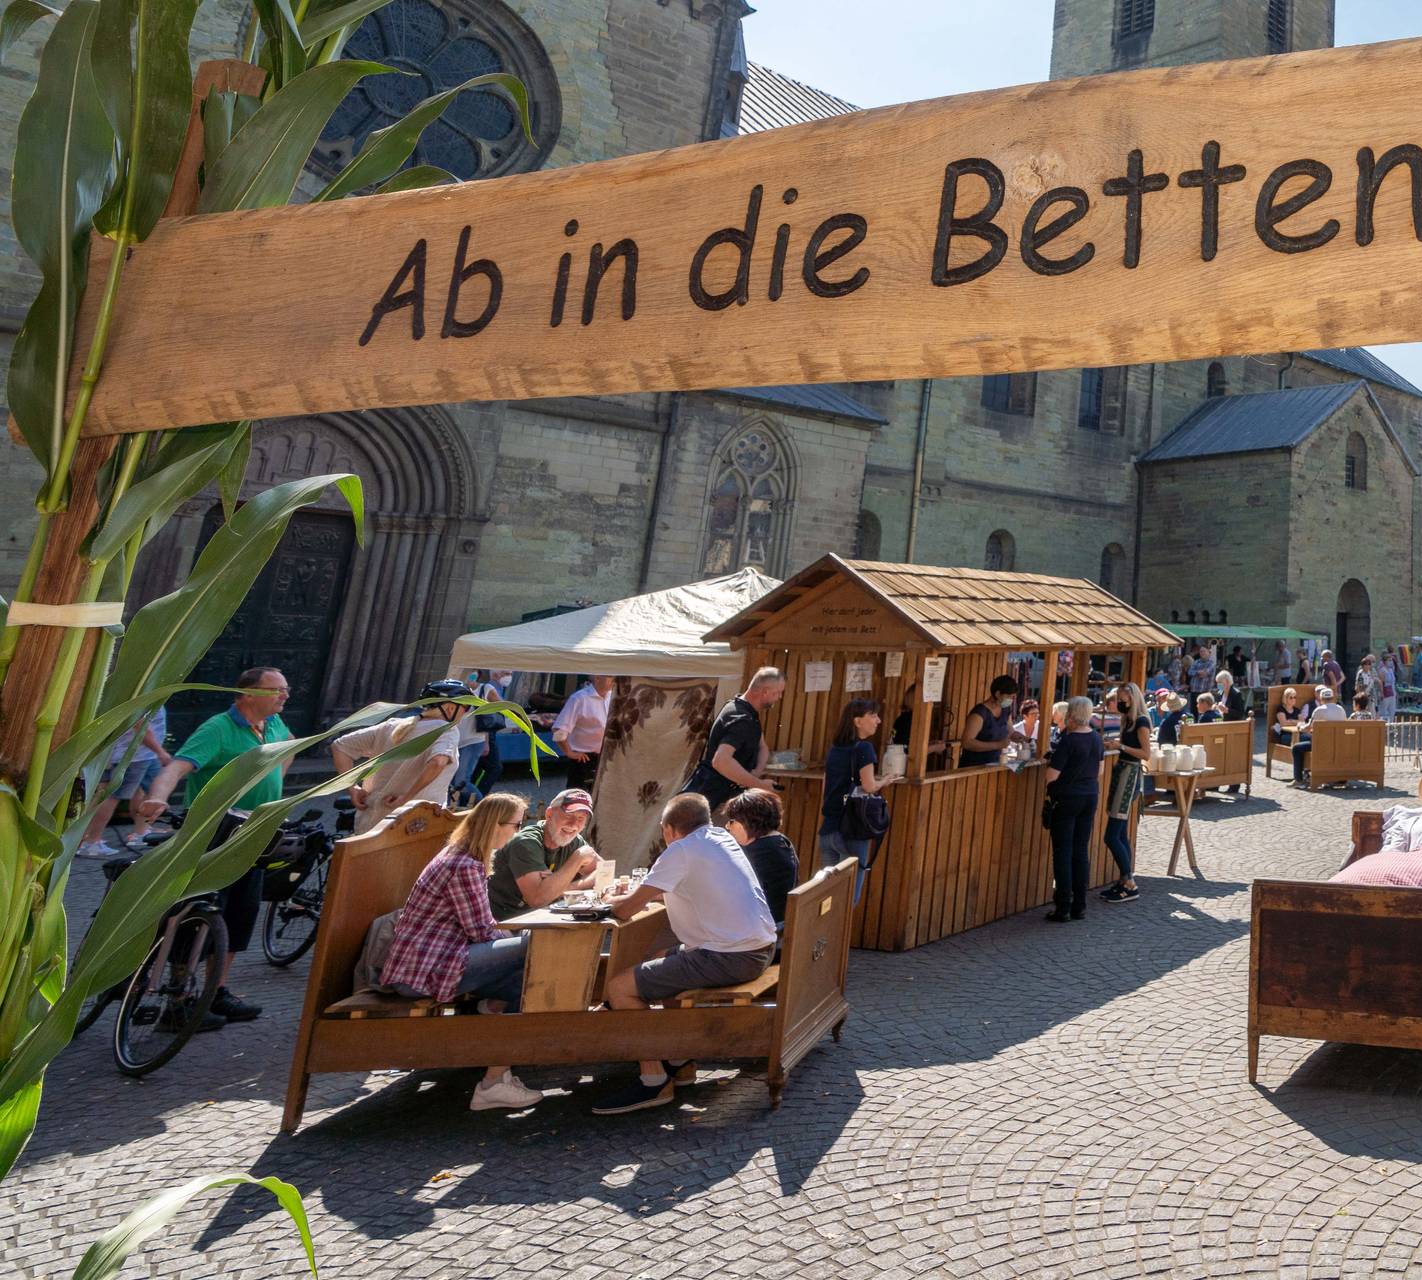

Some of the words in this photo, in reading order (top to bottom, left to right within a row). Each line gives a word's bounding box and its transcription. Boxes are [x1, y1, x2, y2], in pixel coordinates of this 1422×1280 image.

[357, 224, 505, 348] Ab
[548, 217, 641, 329] in
[687, 182, 872, 313] die
